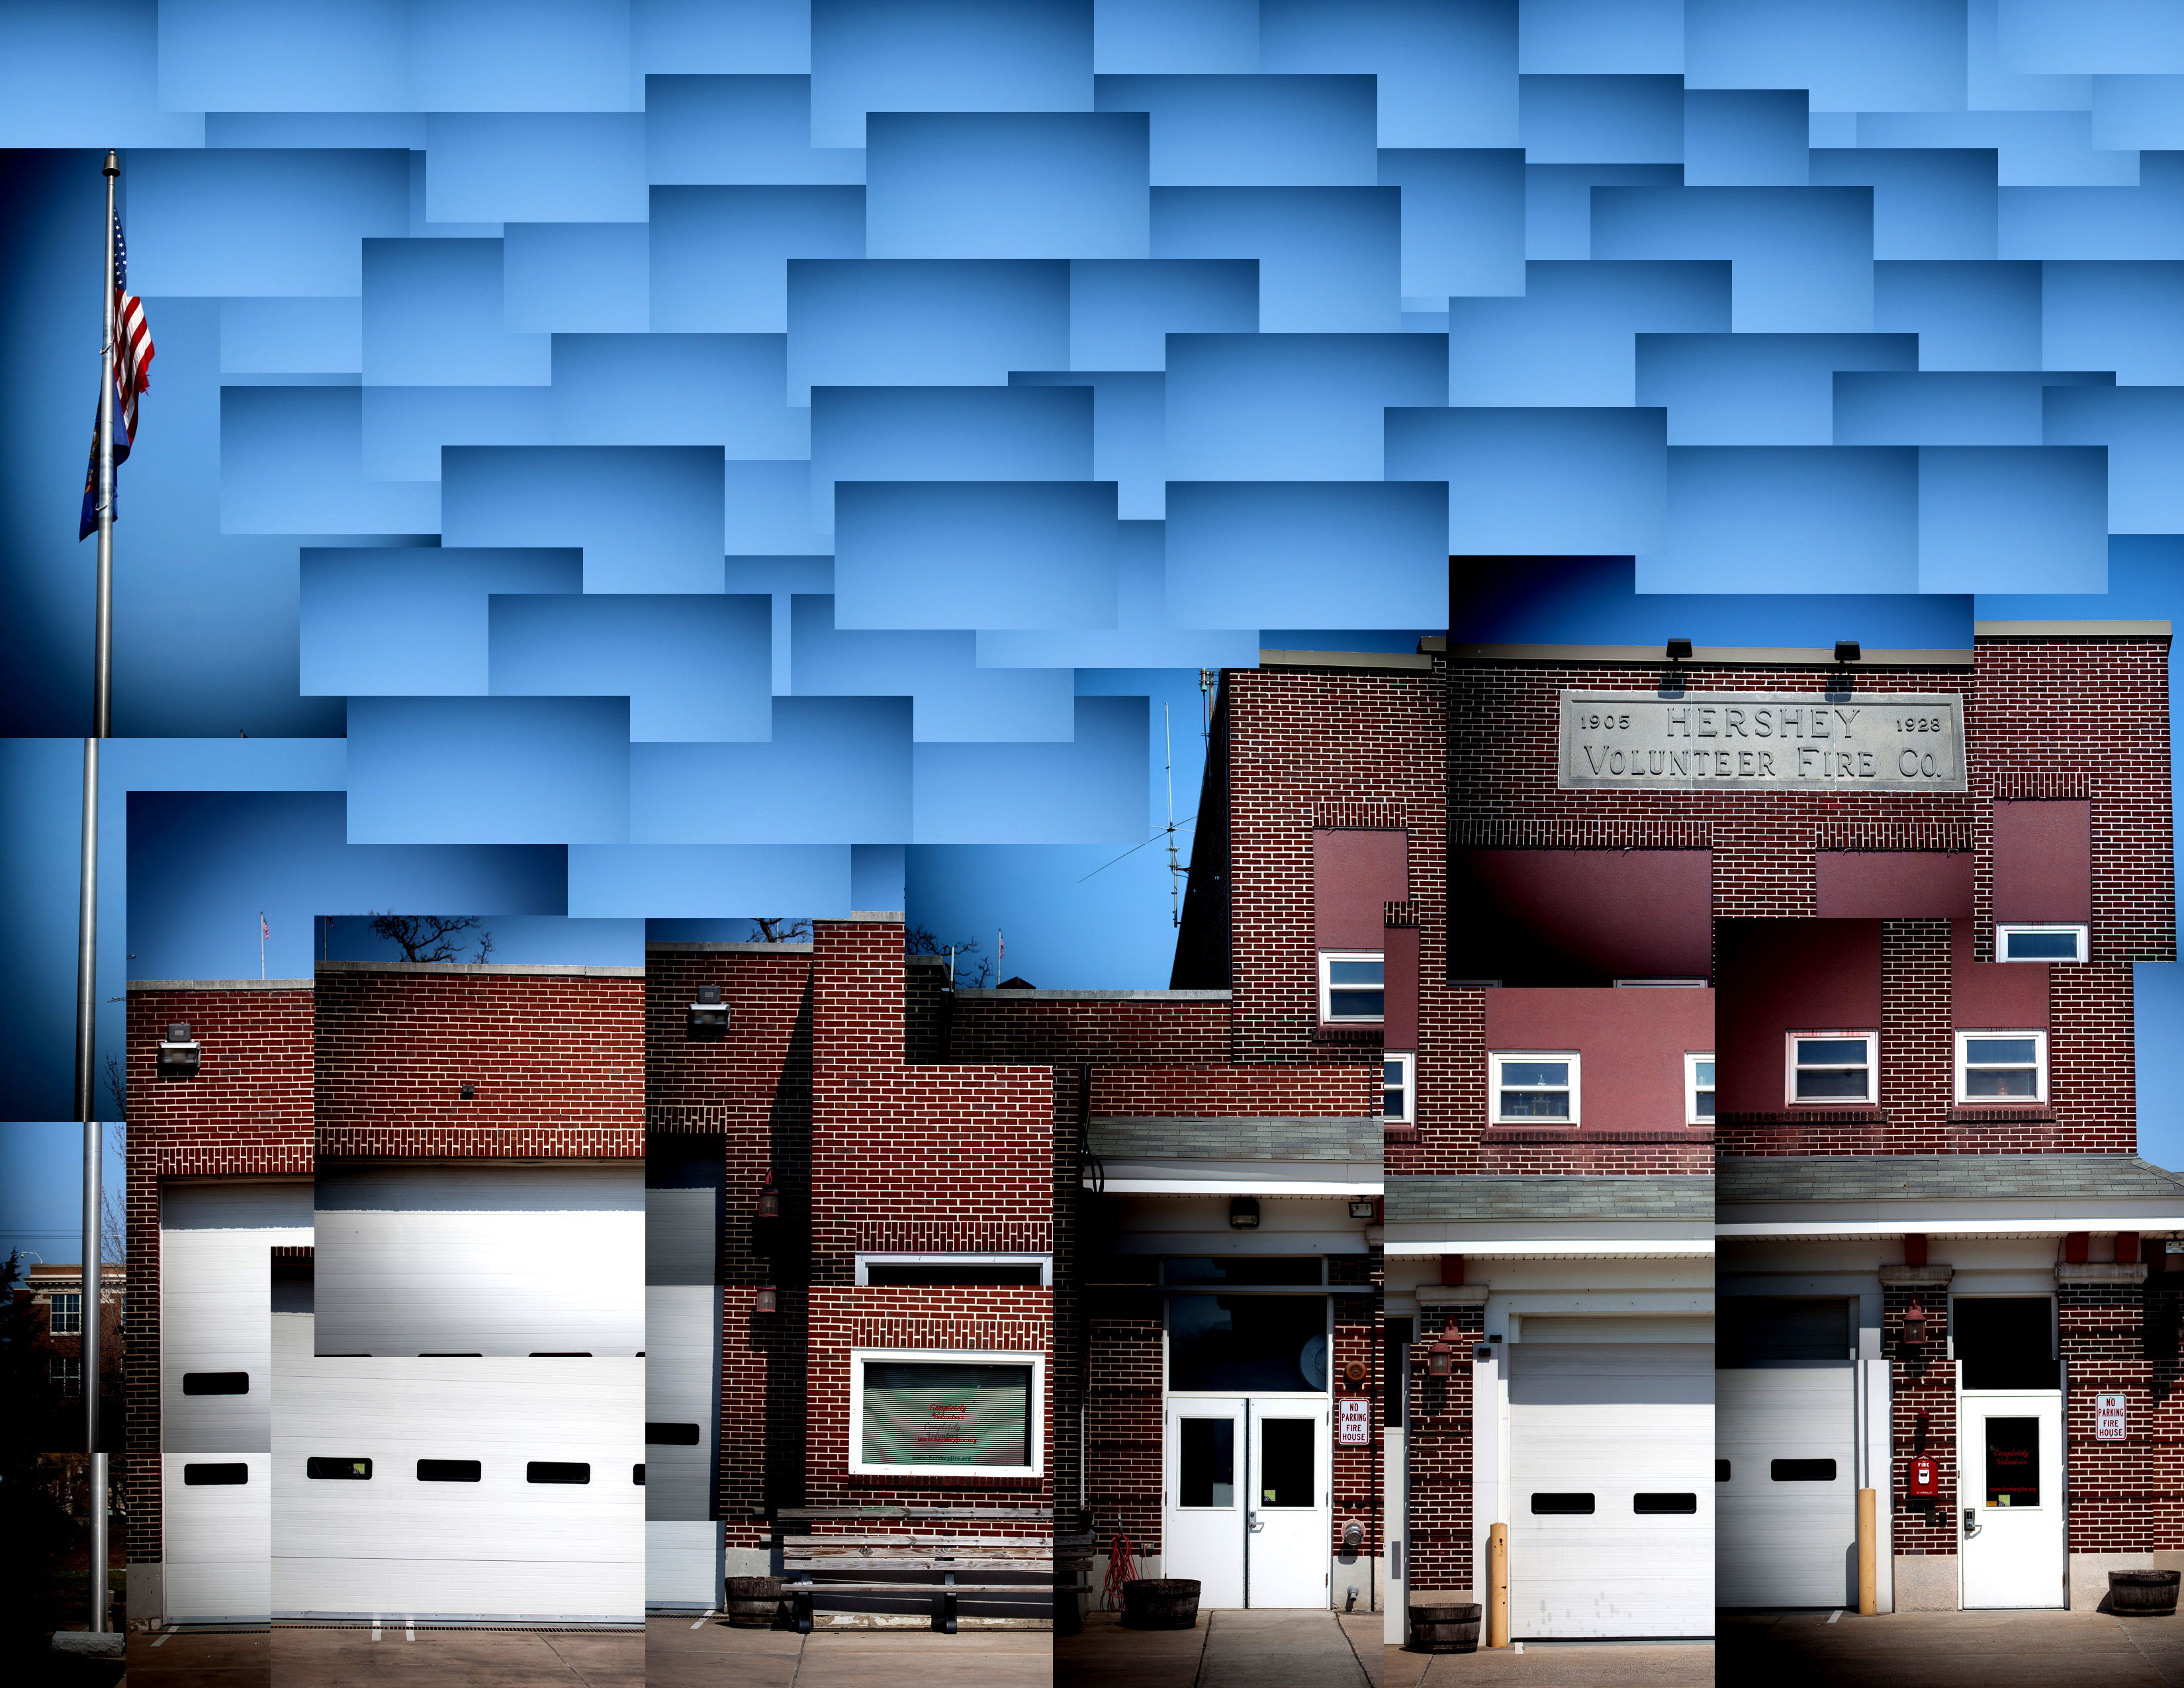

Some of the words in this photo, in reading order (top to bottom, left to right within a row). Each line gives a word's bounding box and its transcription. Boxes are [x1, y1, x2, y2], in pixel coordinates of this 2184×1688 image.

[1581, 714, 1630, 729] 1905
[1666, 707, 1860, 739] HERSHEY
[1896, 717, 1941, 732] 1928
[2106, 1397, 2115, 1407] NO
[929, 1403, 967, 1413] Completely
[1349, 1403, 1359, 1412] NO
[2098, 1408, 2124, 1417] PARKING
[1342, 1413, 1367, 1422] PARKING
[1993, 1449, 2030, 1458] Completely
